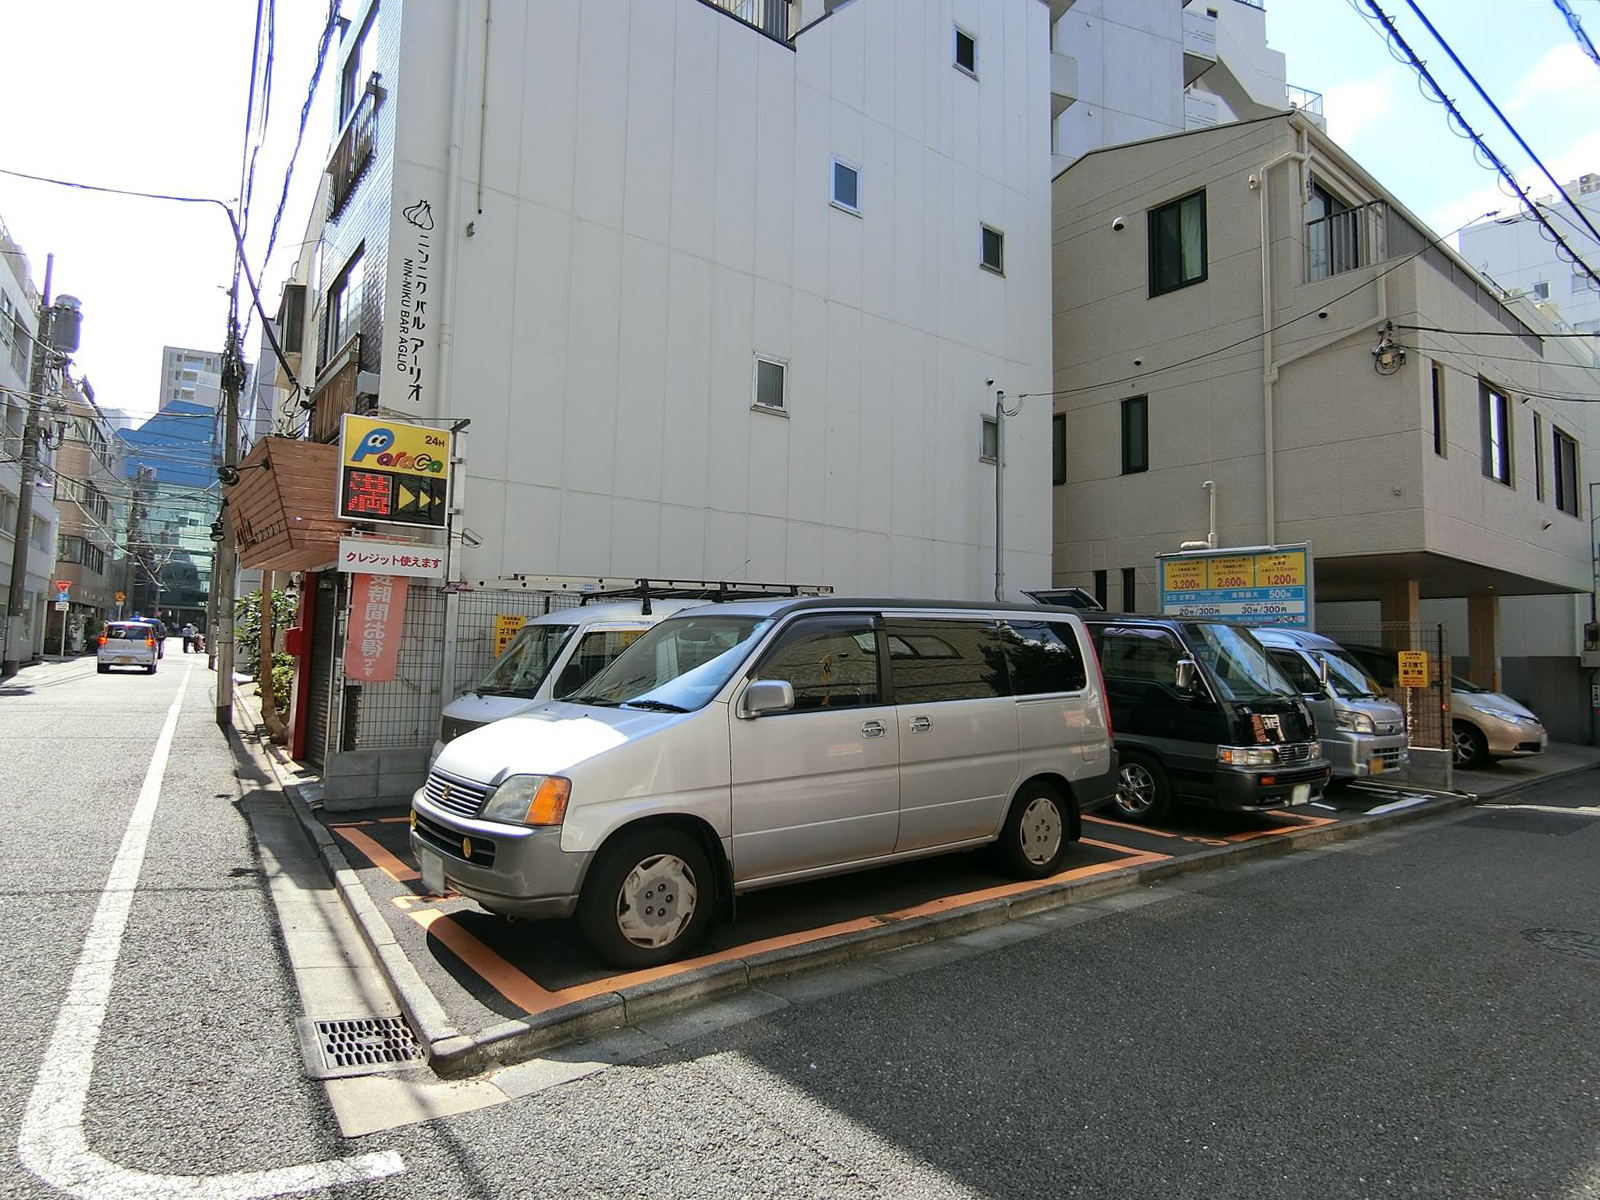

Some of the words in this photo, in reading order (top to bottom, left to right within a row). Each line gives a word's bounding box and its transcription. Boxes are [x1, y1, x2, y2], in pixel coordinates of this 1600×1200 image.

[401, 257, 413, 307] NIN-NIKU
[399, 309, 411, 334] BAR
[397, 336, 408, 372] AGLIO
[407, 337, 425, 401] アーリオ
[425, 435, 445, 447] 24H
[346, 551, 442, 569] クレジット使えます
